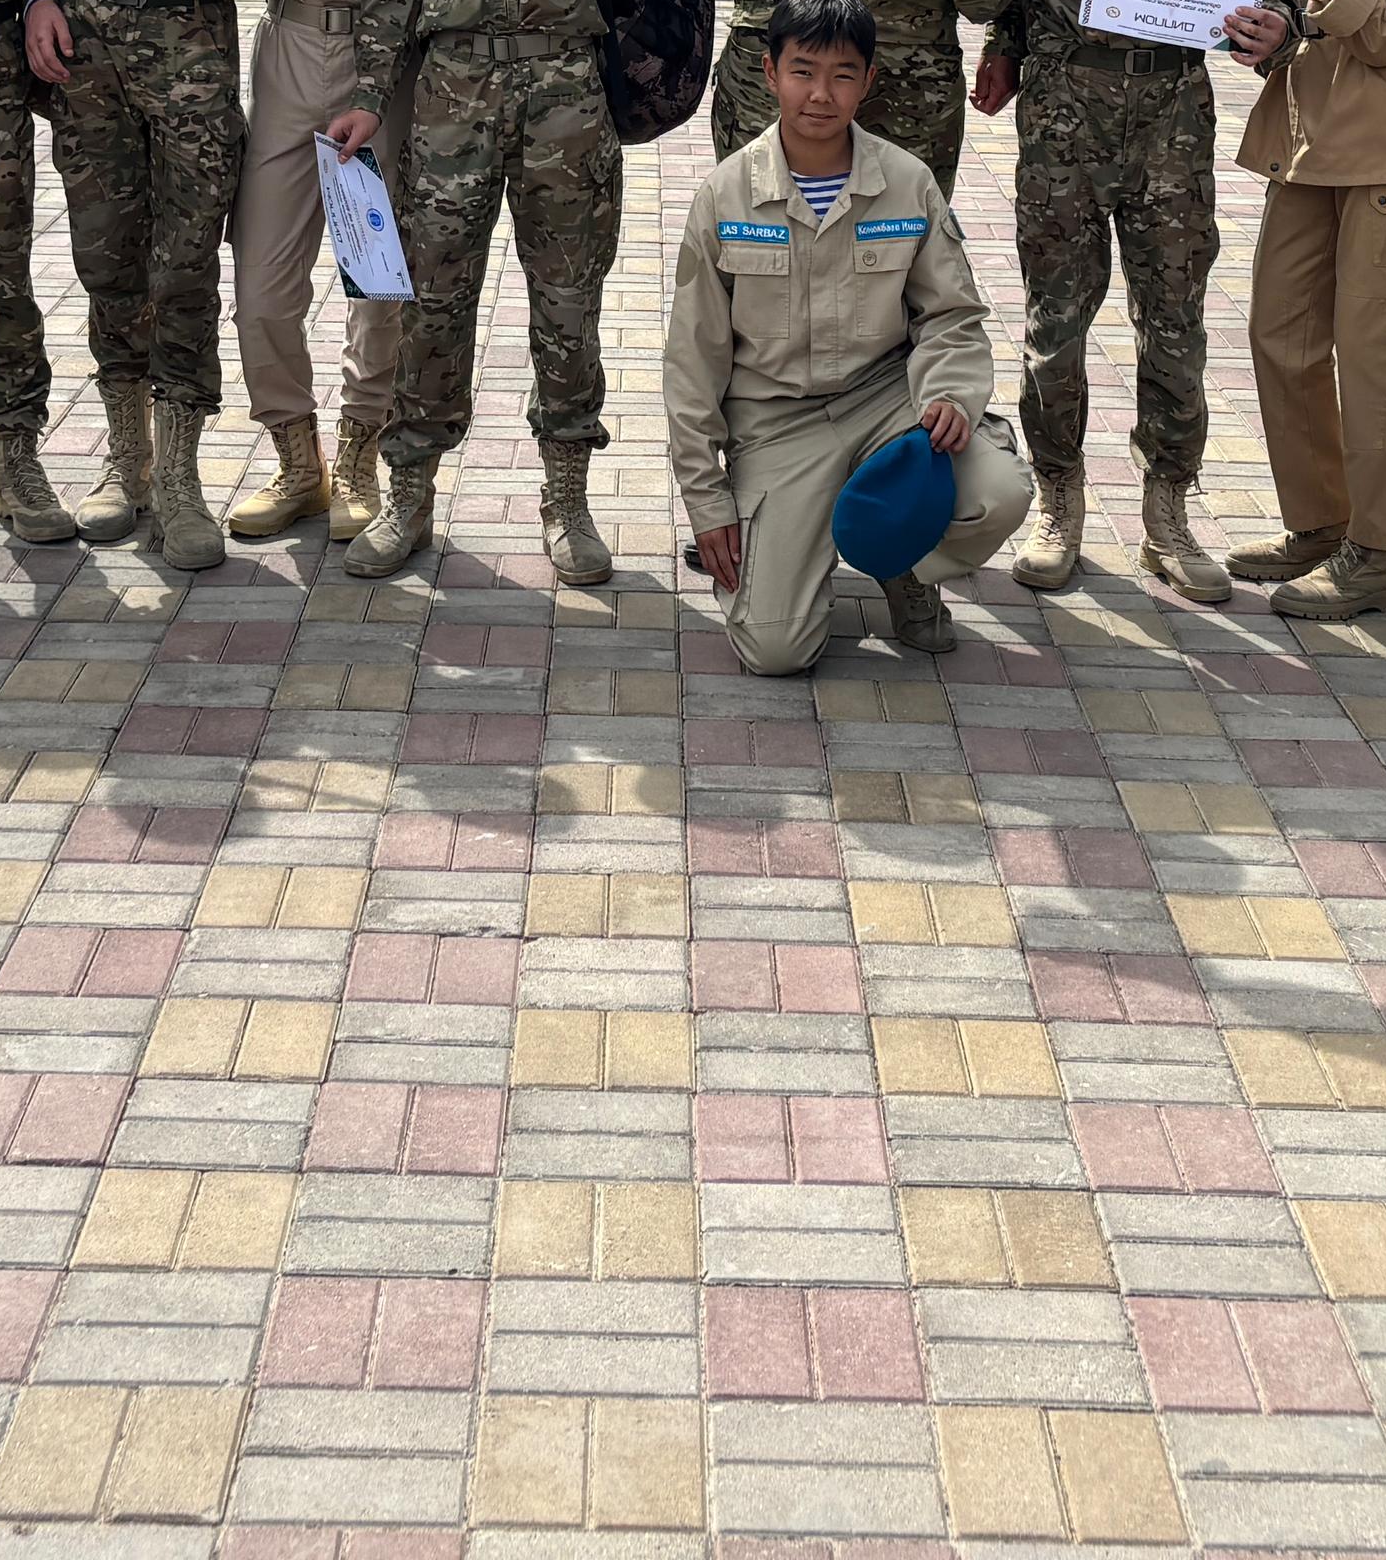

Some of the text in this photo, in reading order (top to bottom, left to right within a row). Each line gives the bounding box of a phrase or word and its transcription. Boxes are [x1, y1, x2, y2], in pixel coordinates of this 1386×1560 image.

[1134, 13, 1195, 33] ДИПЛОМ
[721, 225, 786, 239] JAS SARBAZ
